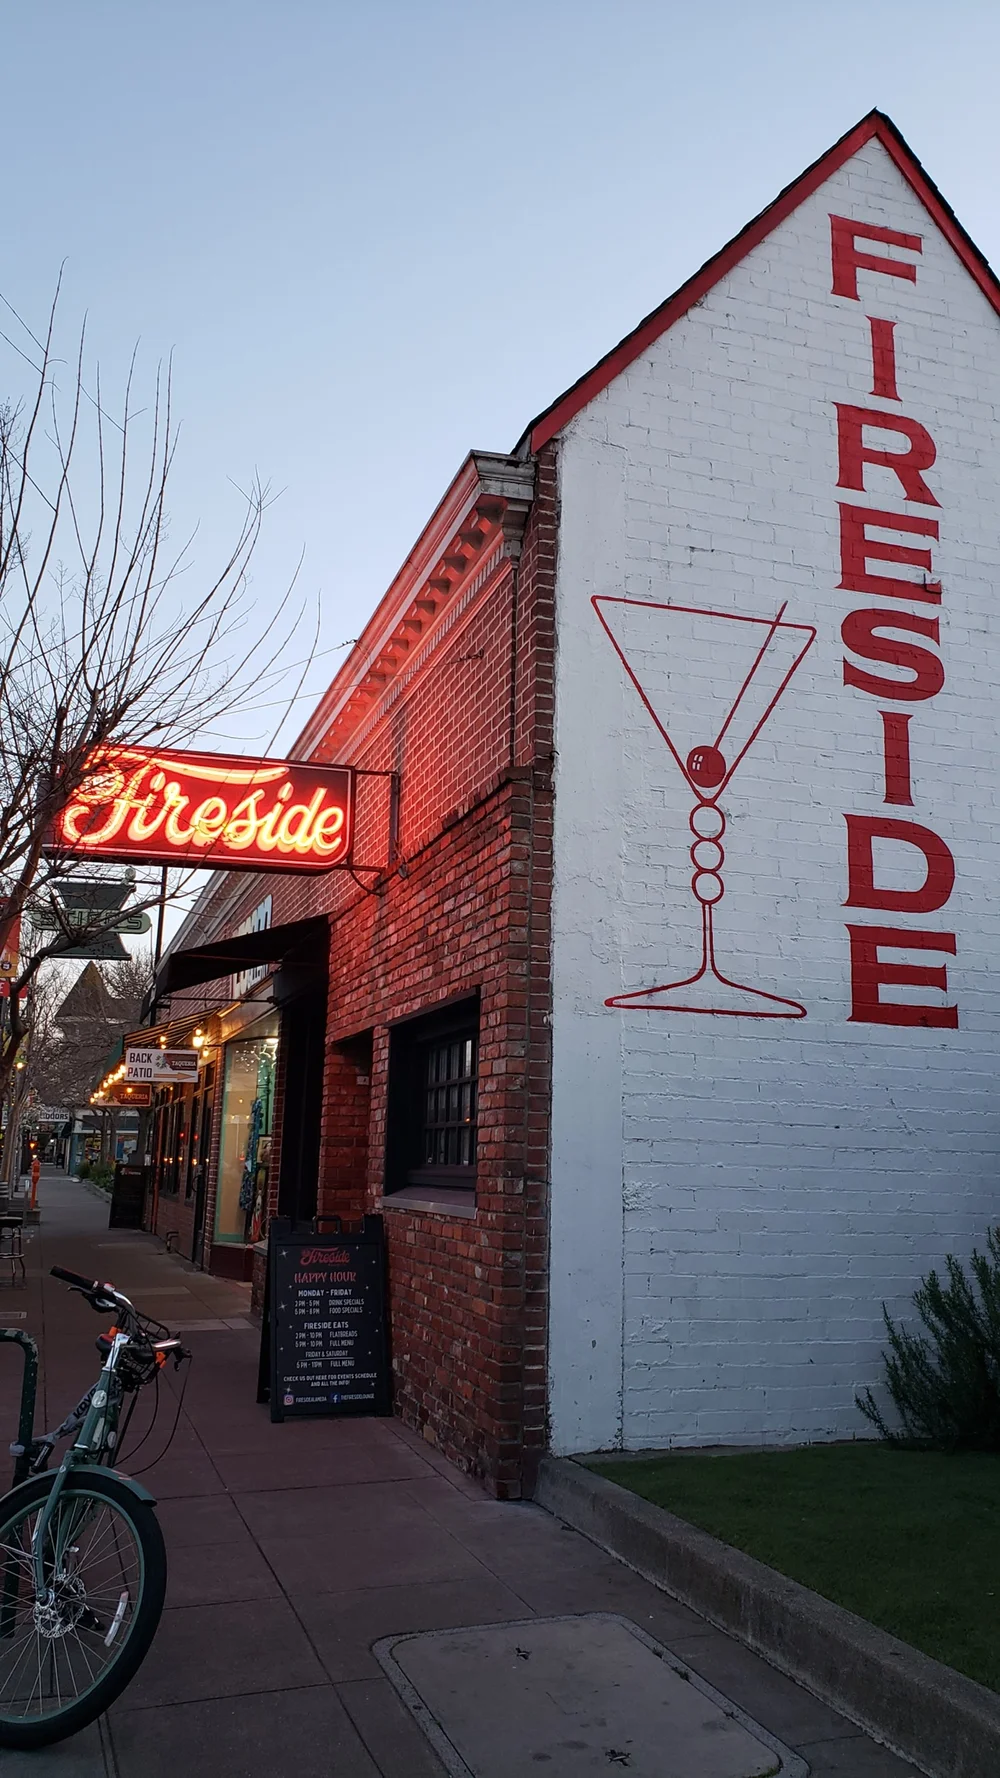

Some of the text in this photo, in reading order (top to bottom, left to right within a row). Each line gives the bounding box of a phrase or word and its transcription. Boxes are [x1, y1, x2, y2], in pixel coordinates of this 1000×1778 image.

[827, 213, 959, 1029] FIRESIDE
[62, 749, 347, 857] Fireside
[130, 1053, 152, 1064] BACK
[128, 1067, 152, 1078] PATIO
[300, 1247, 350, 1265] Fireside
[294, 1271, 356, 1283] HAPPY HOUR
[73, 1384, 98, 1419] KRYP
